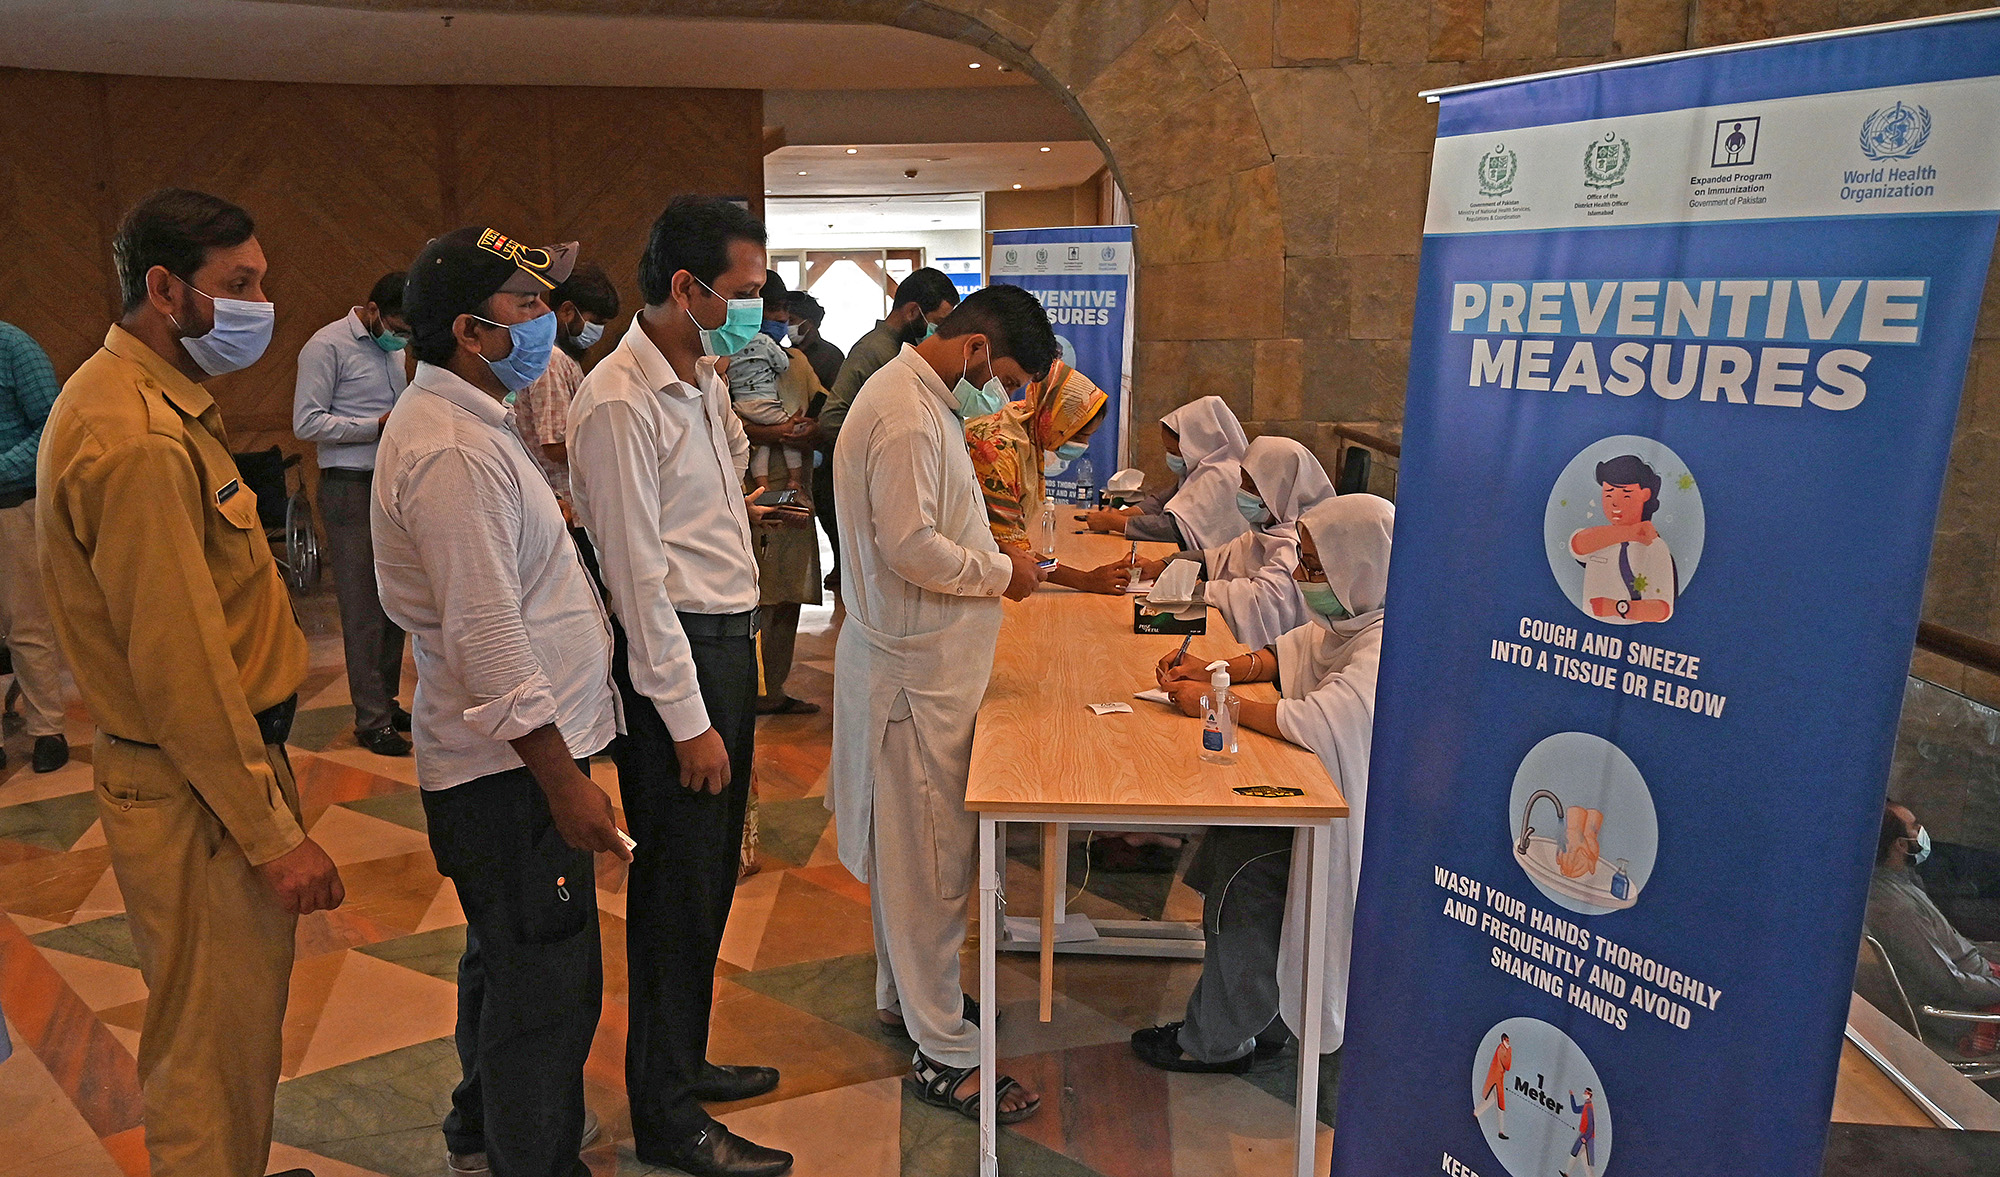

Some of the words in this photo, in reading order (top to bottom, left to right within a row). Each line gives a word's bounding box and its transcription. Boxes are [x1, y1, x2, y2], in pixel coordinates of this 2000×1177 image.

[1690, 174, 1732, 186] Expanded
[1734, 172, 1772, 183] Program
[1708, 184, 1765, 195] Immunization
[1844, 168, 1883, 184] World
[1889, 166, 1936, 181] Health
[1689, 198, 1729, 208] Government
[1729, 197, 1738, 206] of
[1737, 195, 1767, 205] Pakistan
[1840, 183, 1934, 203] Organization
[1029, 290, 1116, 307] VENTIVE
[1450, 279, 1926, 343] PREVENTIVE
[1046, 308, 1109, 325] SURES
[1468, 338, 1873, 412] MEASURES
[1518, 616, 1578, 650] COUGH
[1581, 632, 1623, 660] AND
[1627, 641, 1700, 680] SNEEZE
[1490, 639, 1532, 668] INTO
[1536, 650, 1548, 672] A
[1553, 653, 1617, 690] TISSUE
[1622, 671, 1648, 699] OR
[1652, 679, 1727, 719] ELBOW
[1434, 865, 1481, 902] WASH
[1485, 885, 1528, 924] YOUR
[1530, 908, 1590, 951] HANDS
[1595, 935, 1722, 1012] THOROUGHLY
[1443, 897, 1477, 928] AND
[1481, 912, 1585, 978] FREQUENTLY
[1588, 964, 1626, 999] AND
[1630, 985, 1691, 1030] AVOID
[1490, 946, 1563, 998] SHAKING
[1567, 983, 1628, 1031] HANDS
[1514, 1075, 1564, 1115] Meter
[1537, 1073, 1545, 1090] 1
